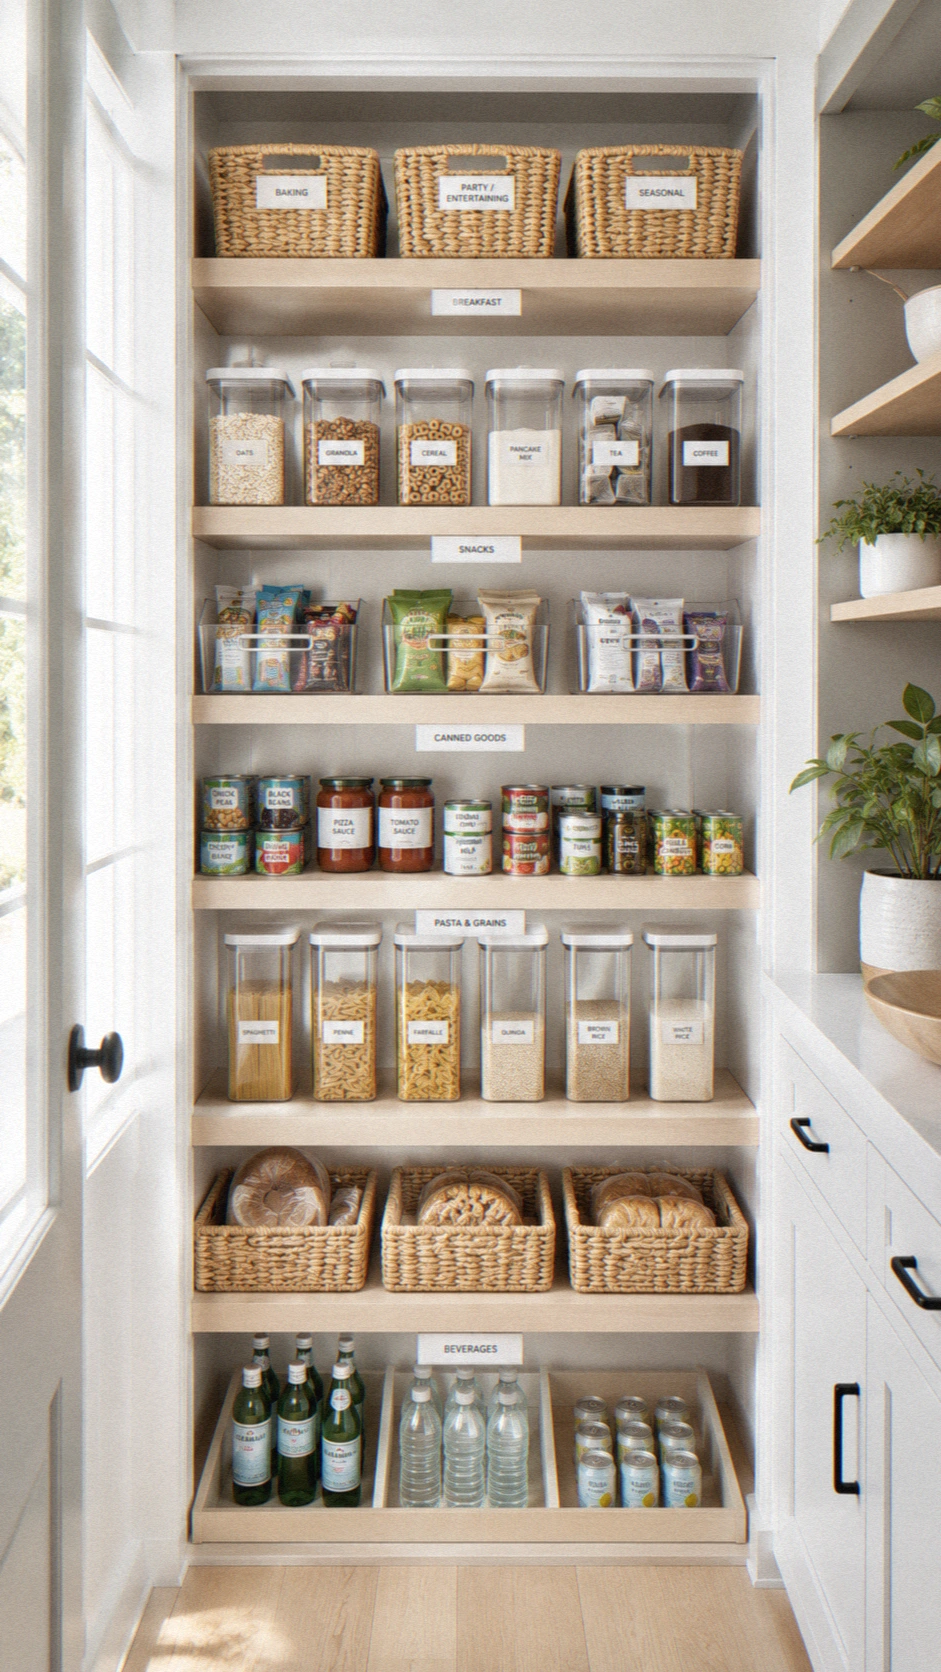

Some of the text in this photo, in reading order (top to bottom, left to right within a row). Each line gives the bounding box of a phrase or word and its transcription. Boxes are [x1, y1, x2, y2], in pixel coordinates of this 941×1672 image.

[461, 183, 495, 192] PARTY /
[275, 188, 308, 197] BAKING
[638, 188, 685, 197] SEASONAL
[446, 194, 510, 203] ENTERTAINING
[453, 298, 502, 306] BREAKFAST
[236, 449, 254, 457] OATS
[325, 449, 358, 457] GRANOLA
[421, 449, 447, 457] CEREAL
[509, 445, 542, 453] PANCAKE
[609, 449, 622, 457] TEA
[693, 449, 719, 457] COFFEE
[459, 545, 495, 554] SNACKS
[434, 734, 506, 742] CANNED GOODS
[333, 819, 354, 827] PIZZA
[391, 819, 420, 827] TOMATO
[332, 828, 355, 836] SAUCE
[393, 828, 417, 836] SAUCE
[434, 919, 507, 927] PASTA & GRAINS
[444, 1345, 497, 1353] BEVERAGES
